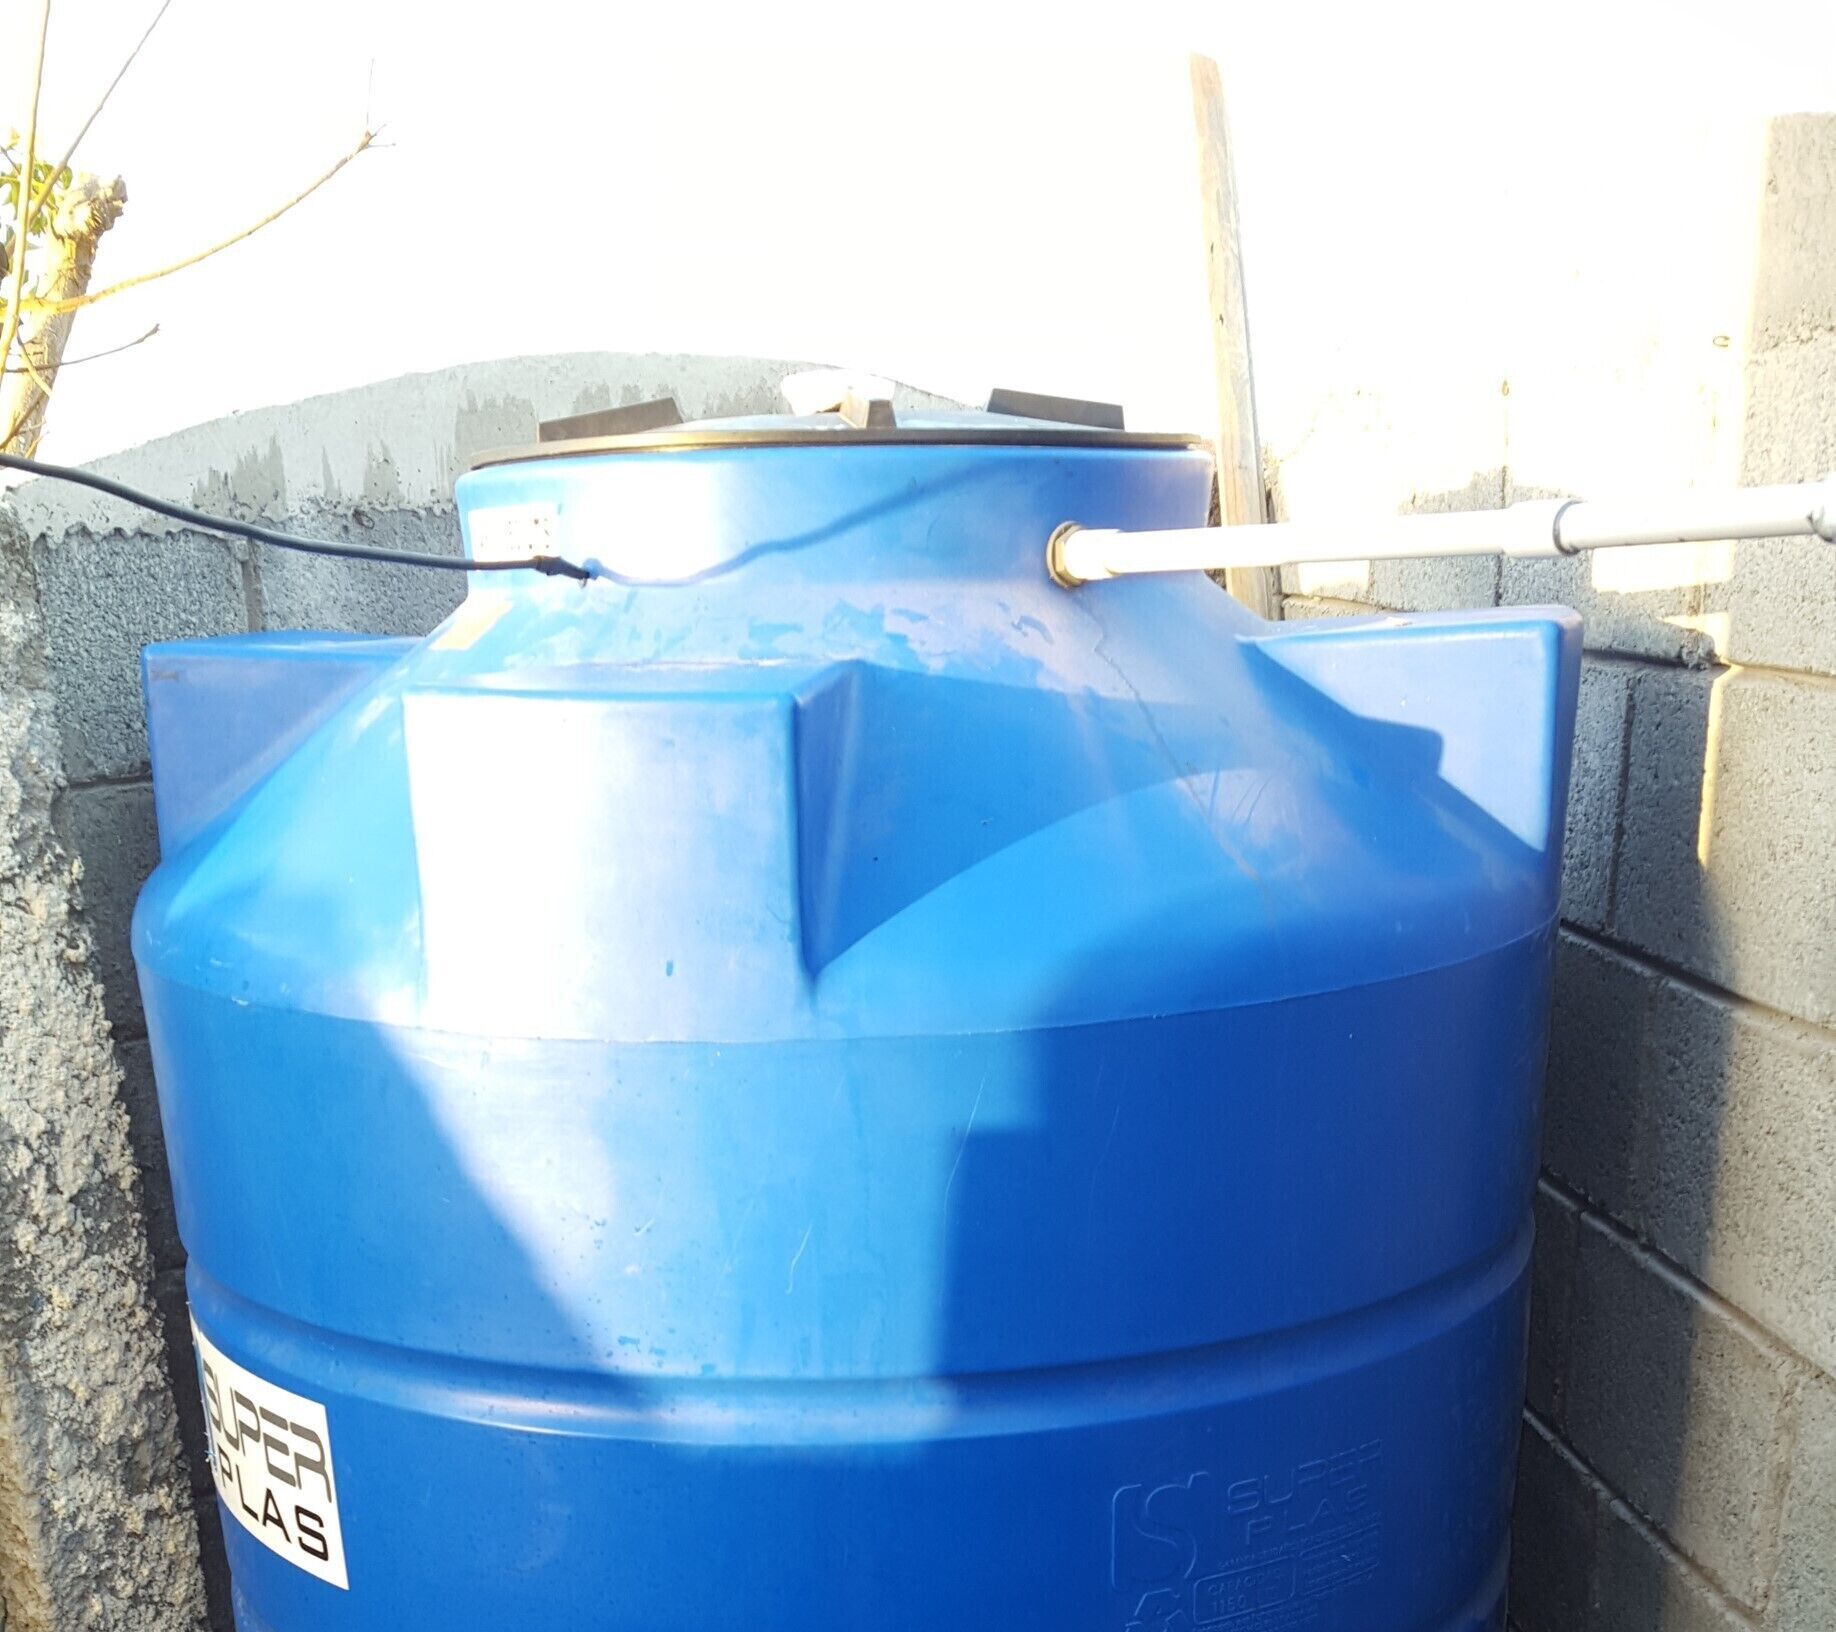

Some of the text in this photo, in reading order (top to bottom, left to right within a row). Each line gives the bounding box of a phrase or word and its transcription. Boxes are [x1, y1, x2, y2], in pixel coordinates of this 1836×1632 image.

[202, 1359, 332, 1503] SUPER
[217, 1442, 329, 1561] PLAS
[1246, 1483, 1368, 1545] PLAS
